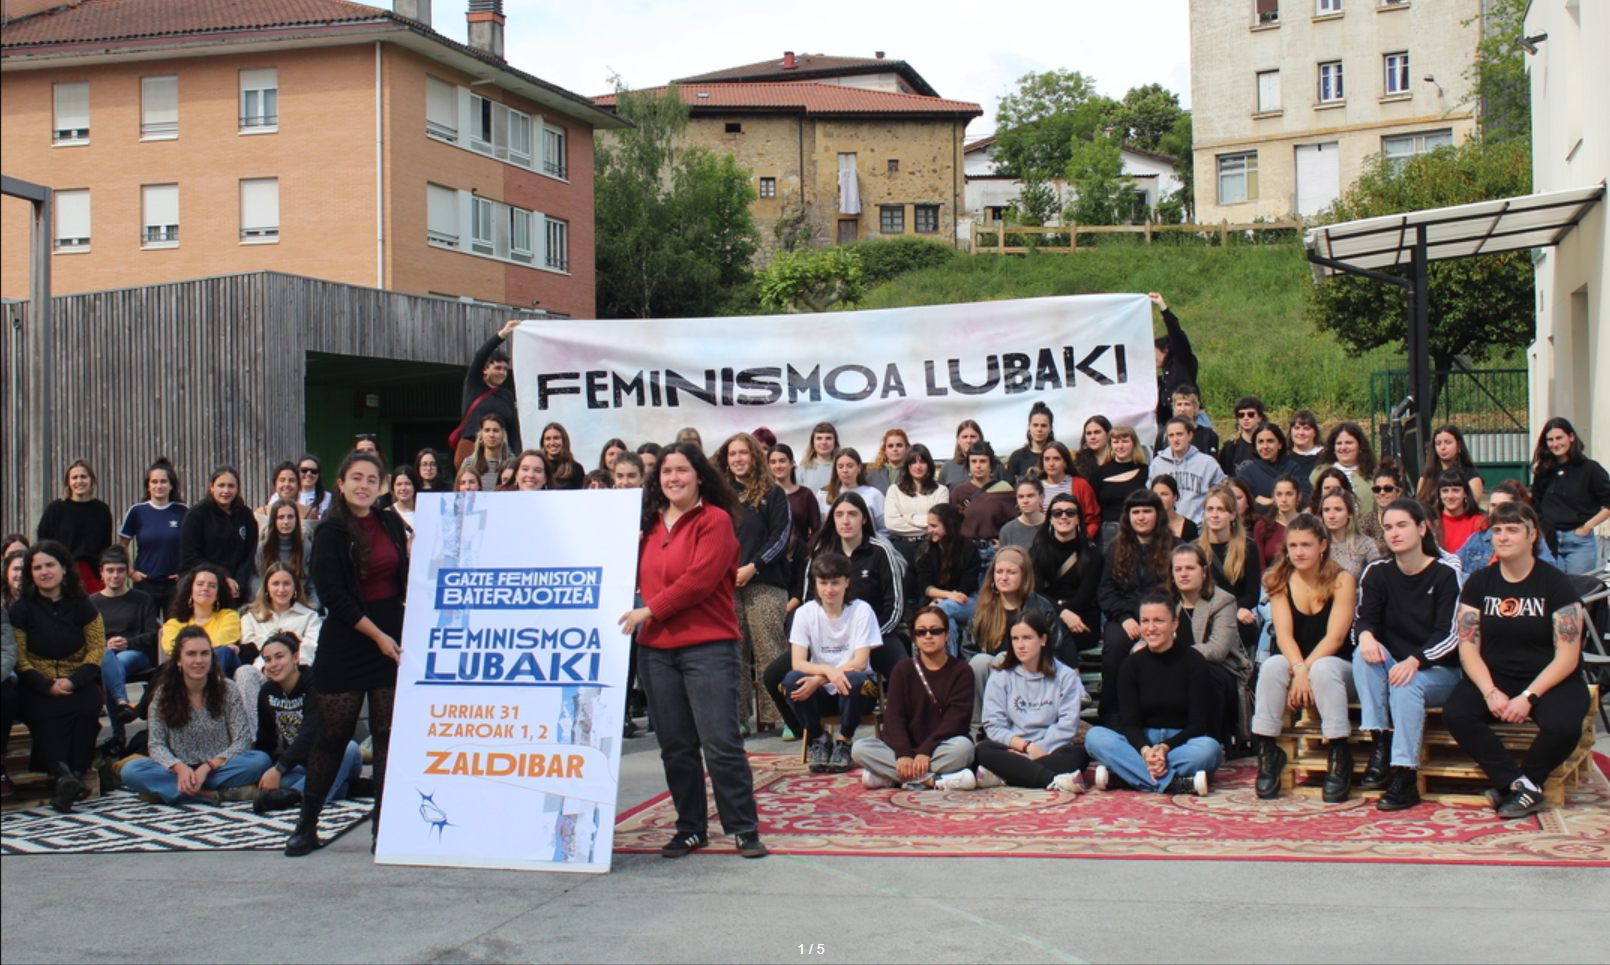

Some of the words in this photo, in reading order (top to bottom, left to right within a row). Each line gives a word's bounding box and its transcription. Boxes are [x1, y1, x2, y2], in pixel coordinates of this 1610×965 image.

[538, 362, 907, 410] FEMINISMOA
[924, 344, 1128, 397] LUBAKI
[444, 572, 494, 587] GAZTE
[497, 571, 597, 586] FEMINISTON
[442, 587, 594, 605] BATERAJOTZEA
[1484, 596, 1545, 618] TROJAN
[428, 627, 601, 650] FEMINISMOA
[425, 652, 601, 681] LUBAKI
[430, 704, 496, 719] URRIAK
[499, 705, 520, 720] 31
[427, 723, 515, 738] AZAROAK
[520, 725, 534, 742] 1,
[538, 725, 548, 739] 2
[423, 751, 585, 779] ZALDIBAR
